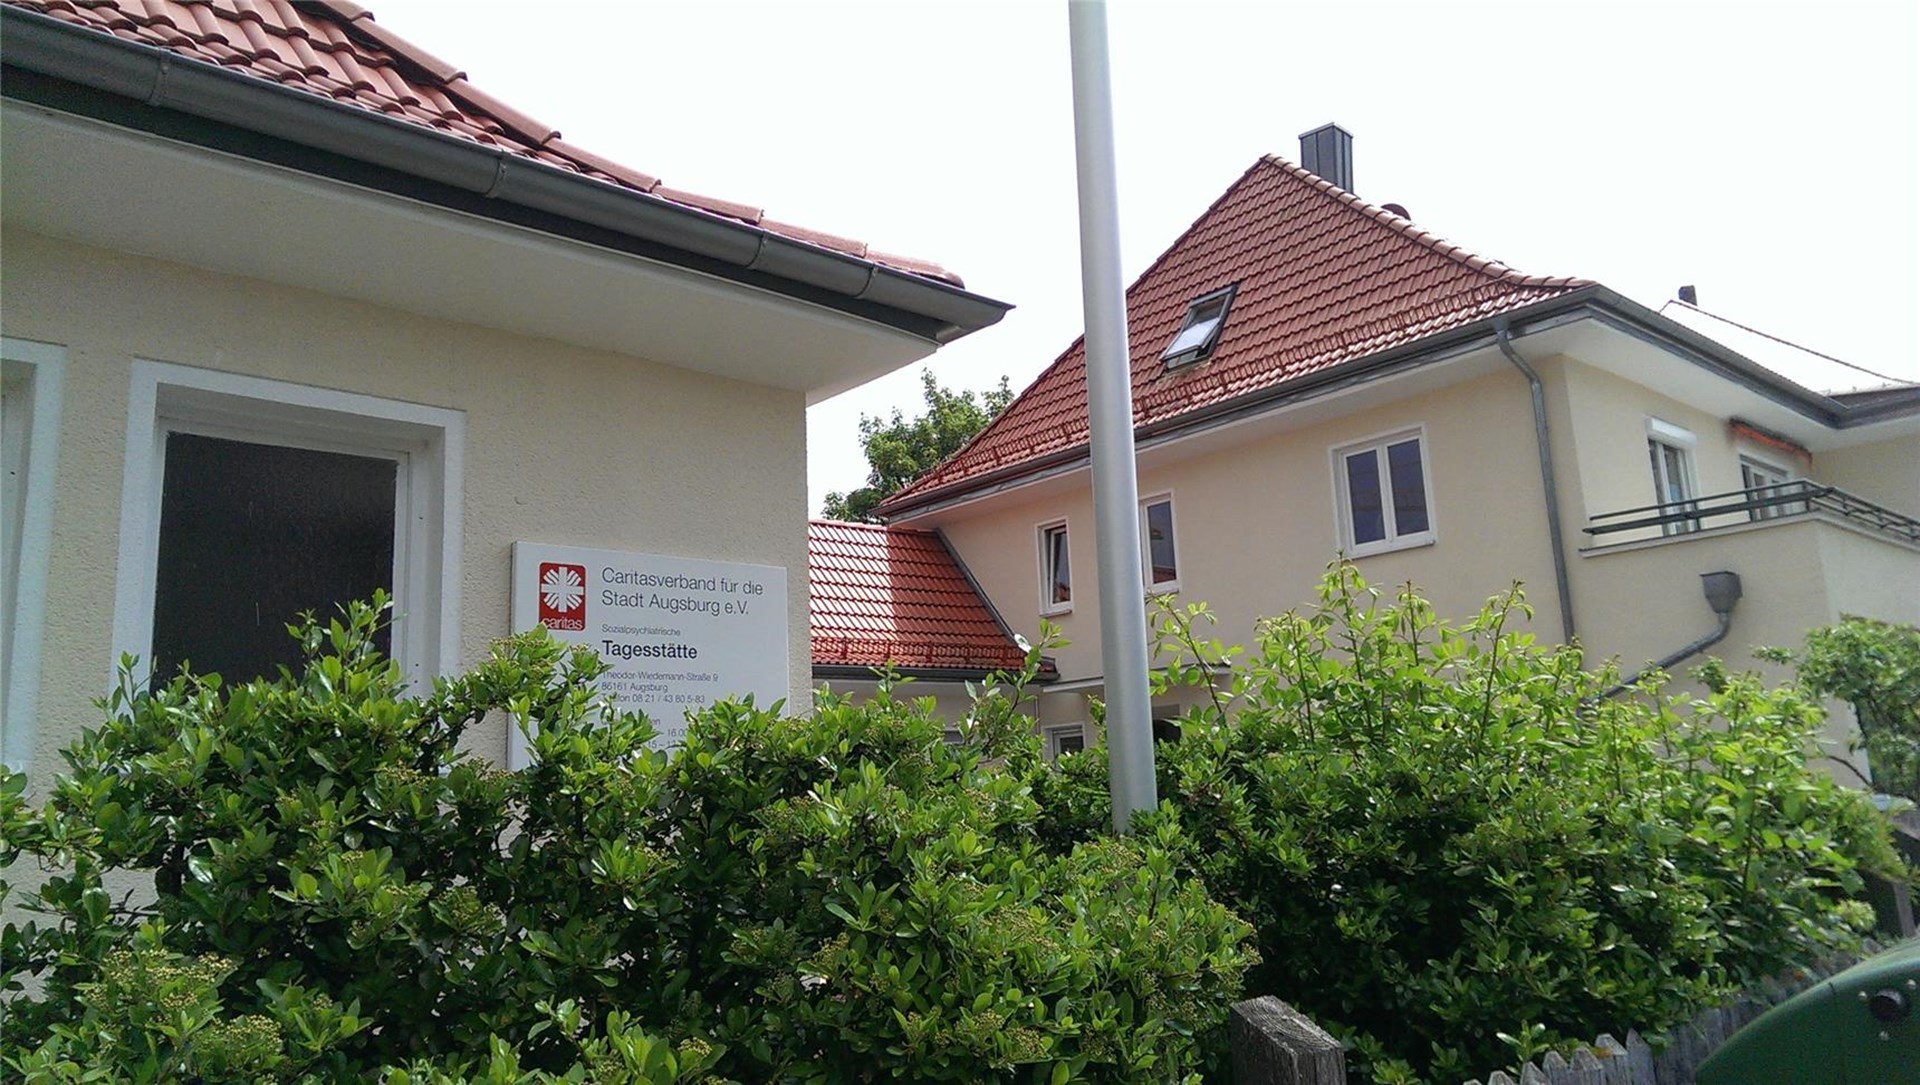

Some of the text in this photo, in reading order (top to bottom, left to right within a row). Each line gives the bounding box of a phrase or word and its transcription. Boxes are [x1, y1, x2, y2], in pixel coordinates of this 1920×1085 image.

[602, 567, 715, 592] Caritasverband
[742, 580, 763, 595] die
[601, 590, 749, 617] Stadt Augsburg e.V.
[543, 616, 583, 630] caritas
[601, 624, 681, 637] Sozialpsychiatrische
[601, 640, 698, 660] Tagesstätte
[601, 682, 668, 693] 86161 Augsburg
